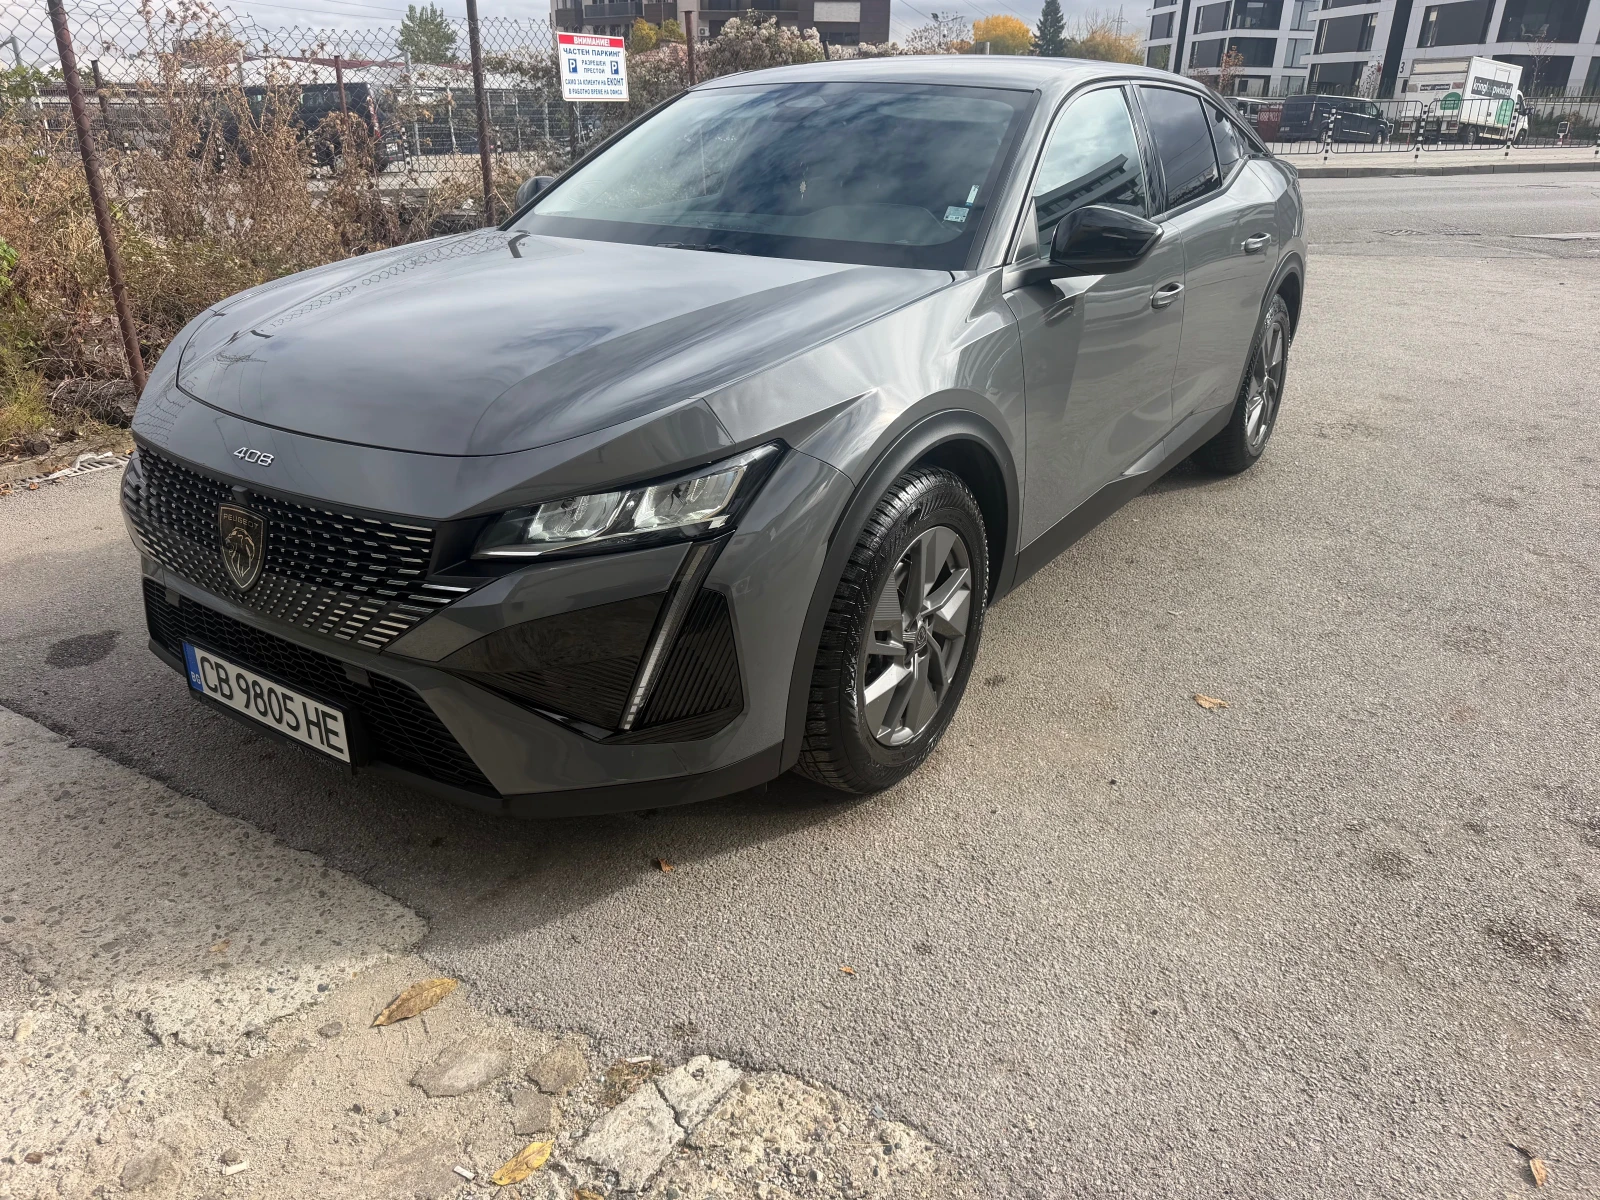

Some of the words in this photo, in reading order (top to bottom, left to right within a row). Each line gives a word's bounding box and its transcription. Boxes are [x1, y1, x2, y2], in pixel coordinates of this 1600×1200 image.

[574, 36, 610, 46] ВНИМАНИЕ!
[563, 48, 590, 56] ЧАСТЕН
[1400, 61, 1405, 73] 3
[607, 78, 623, 86] ЕКОНТ
[234, 446, 274, 467] 408
[223, 513, 258, 528] PEUGEOT
[190, 671, 201, 685] BG
[200, 656, 234, 700] CB
[235, 672, 300, 732] 9805
[302, 702, 344, 754] HE
